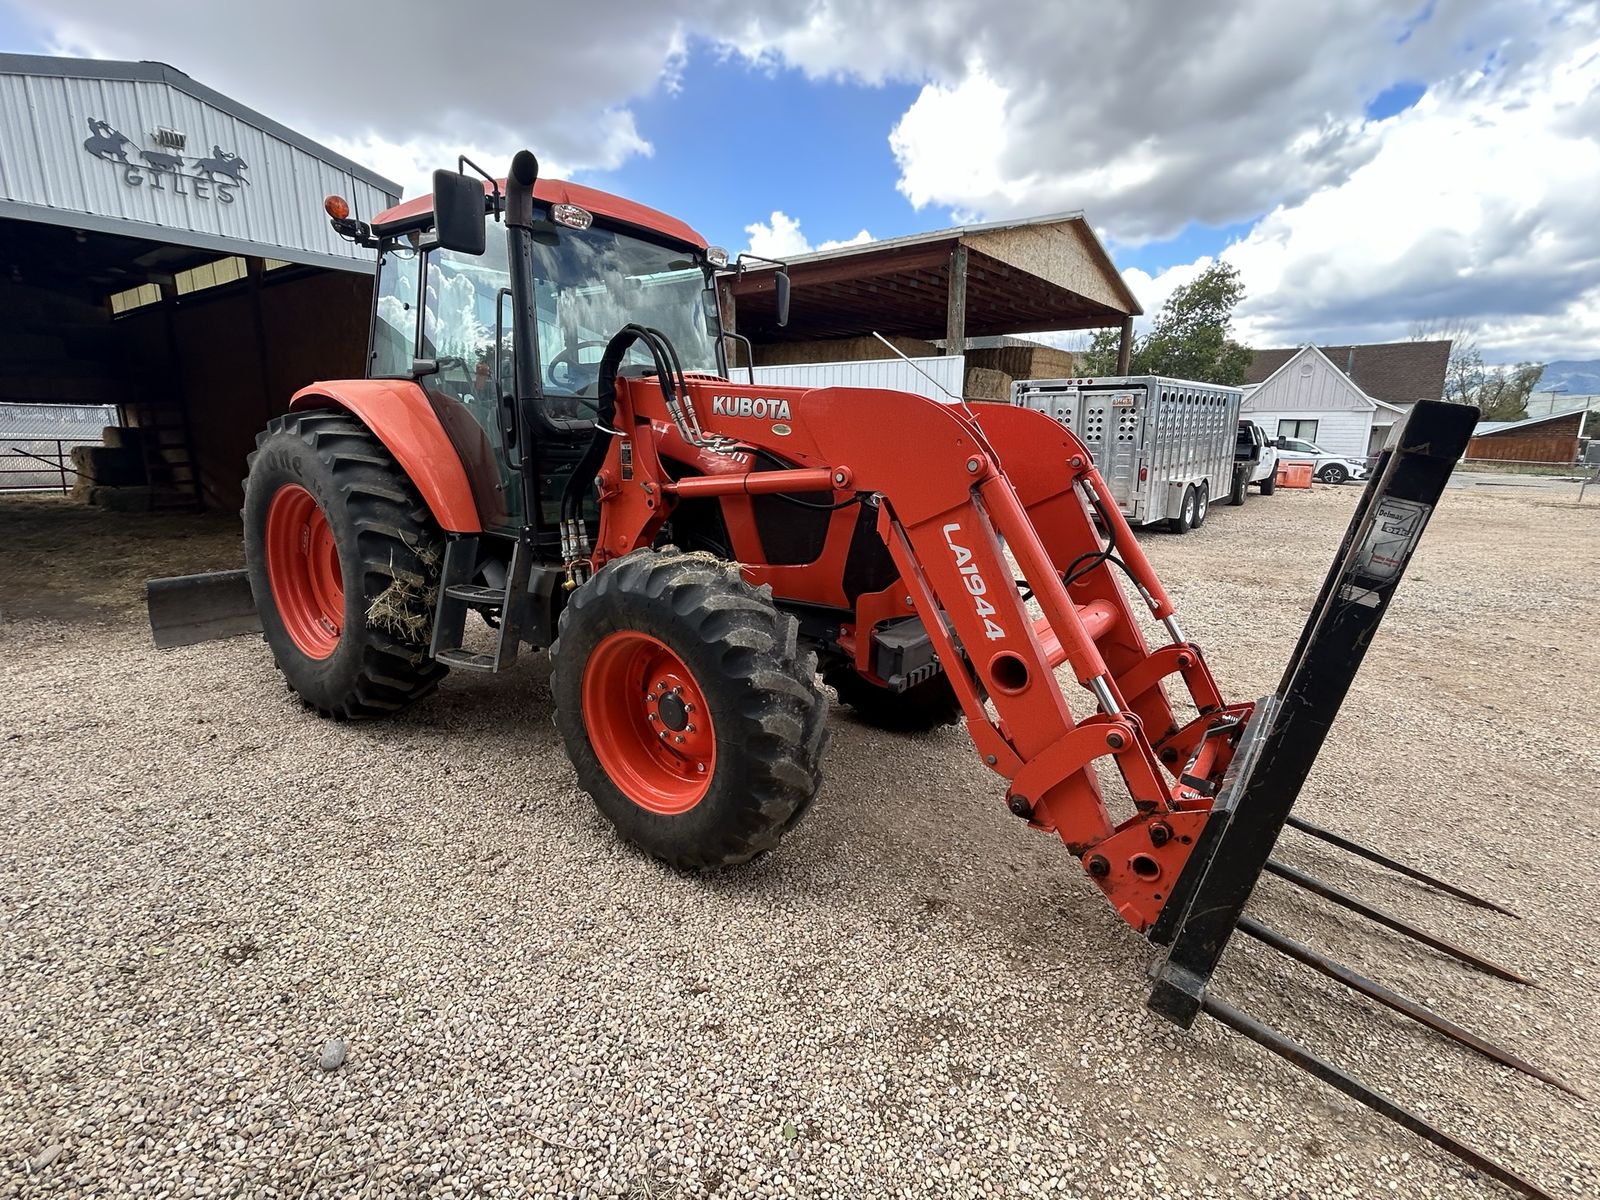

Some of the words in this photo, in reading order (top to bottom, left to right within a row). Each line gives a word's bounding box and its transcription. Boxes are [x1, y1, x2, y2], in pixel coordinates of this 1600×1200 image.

[124, 166, 235, 204] GILES
[712, 395, 792, 420] KUBOTA
[943, 523, 1006, 641] LA1944
